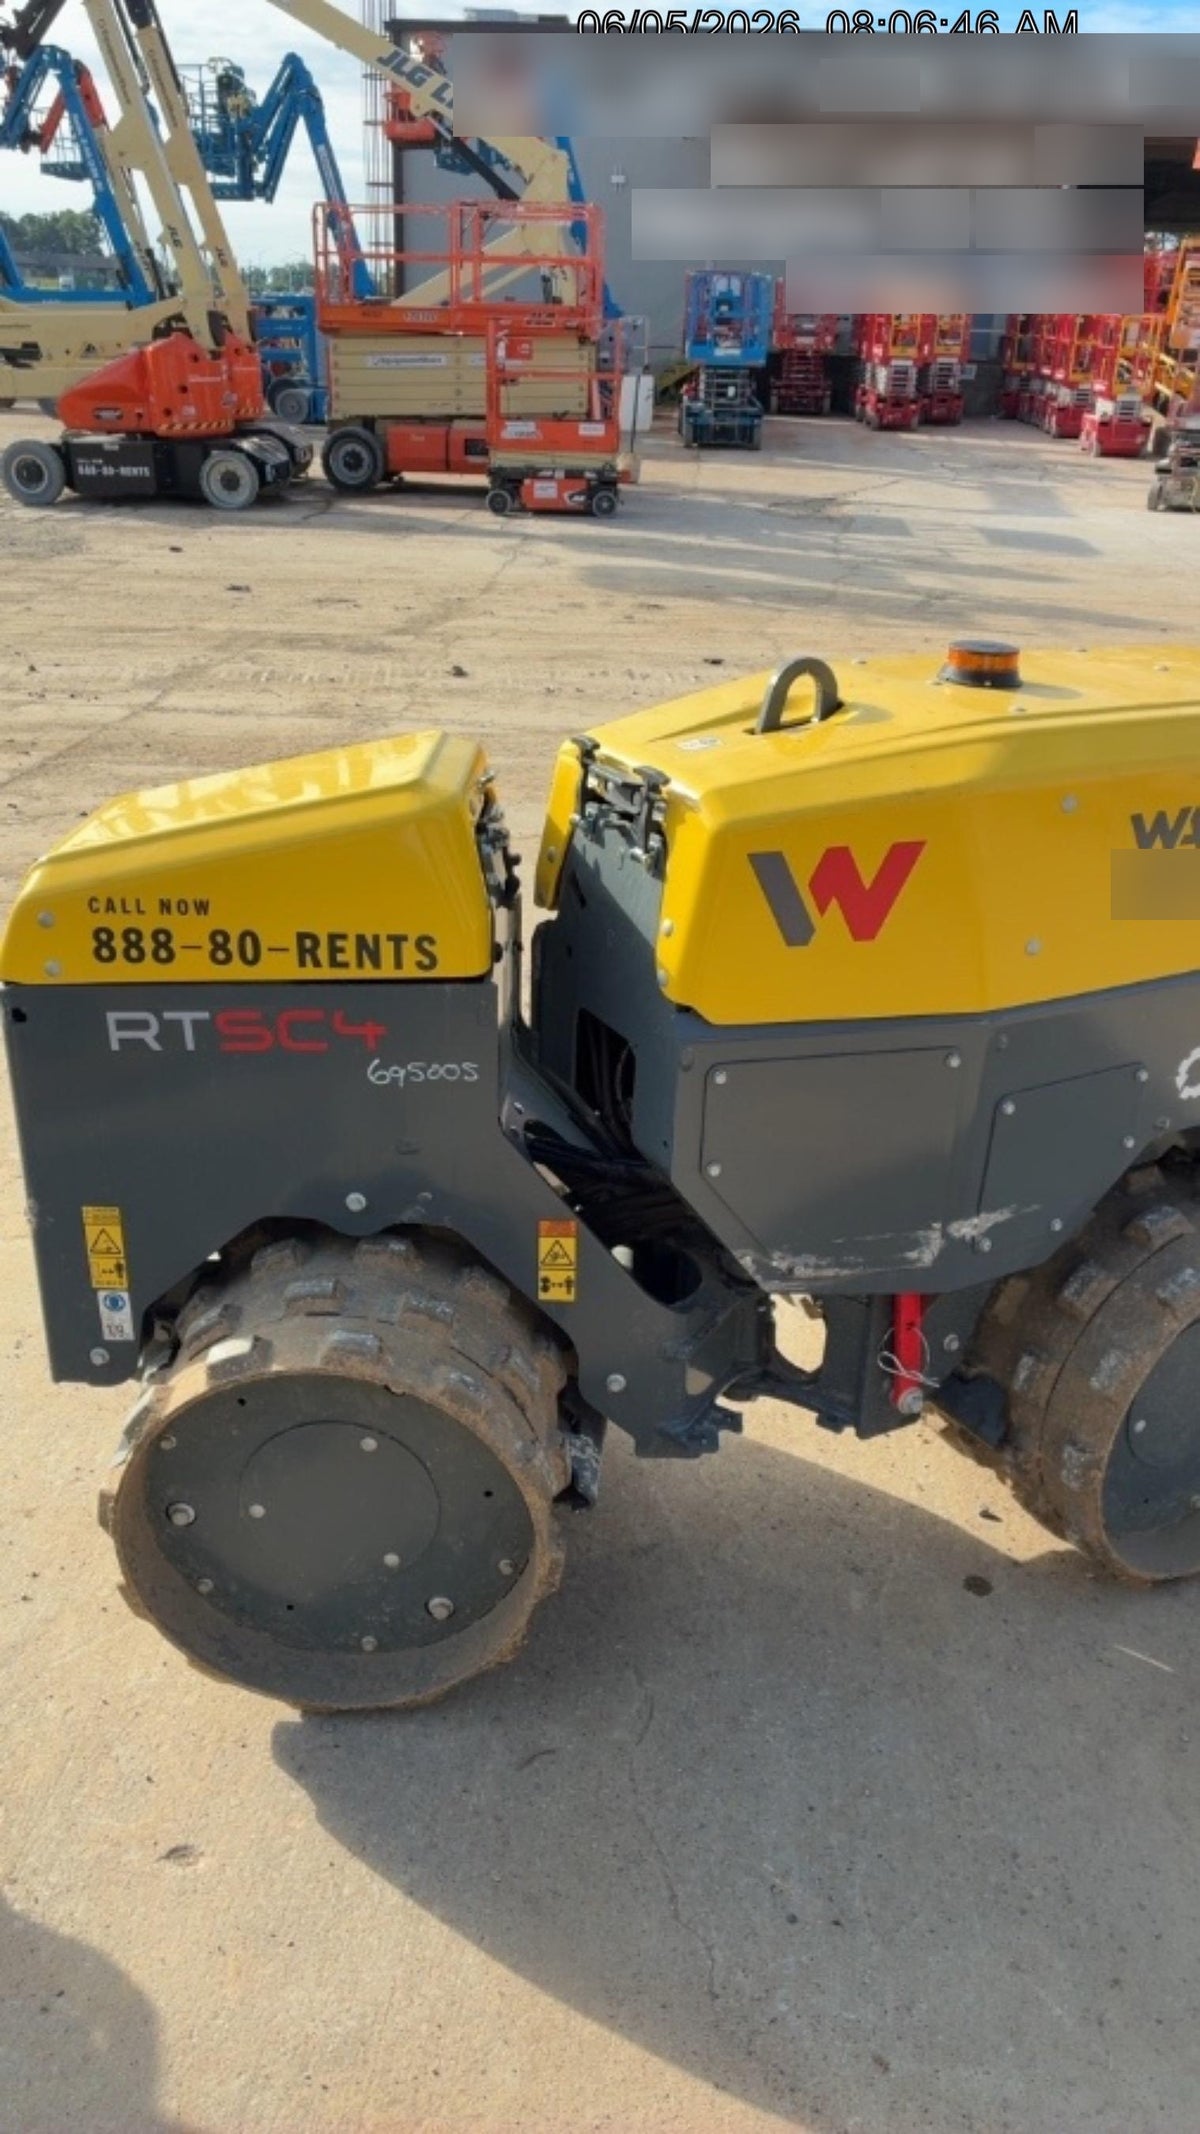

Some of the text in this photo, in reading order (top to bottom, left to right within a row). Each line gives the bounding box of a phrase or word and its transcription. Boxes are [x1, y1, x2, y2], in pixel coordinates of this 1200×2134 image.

[376, 49, 434, 88] JLG
[88, 896, 210, 916] CALL NOW
[92, 926, 438, 971] 888-80-RENTS
[106, 1008, 387, 1054] RTSC4
